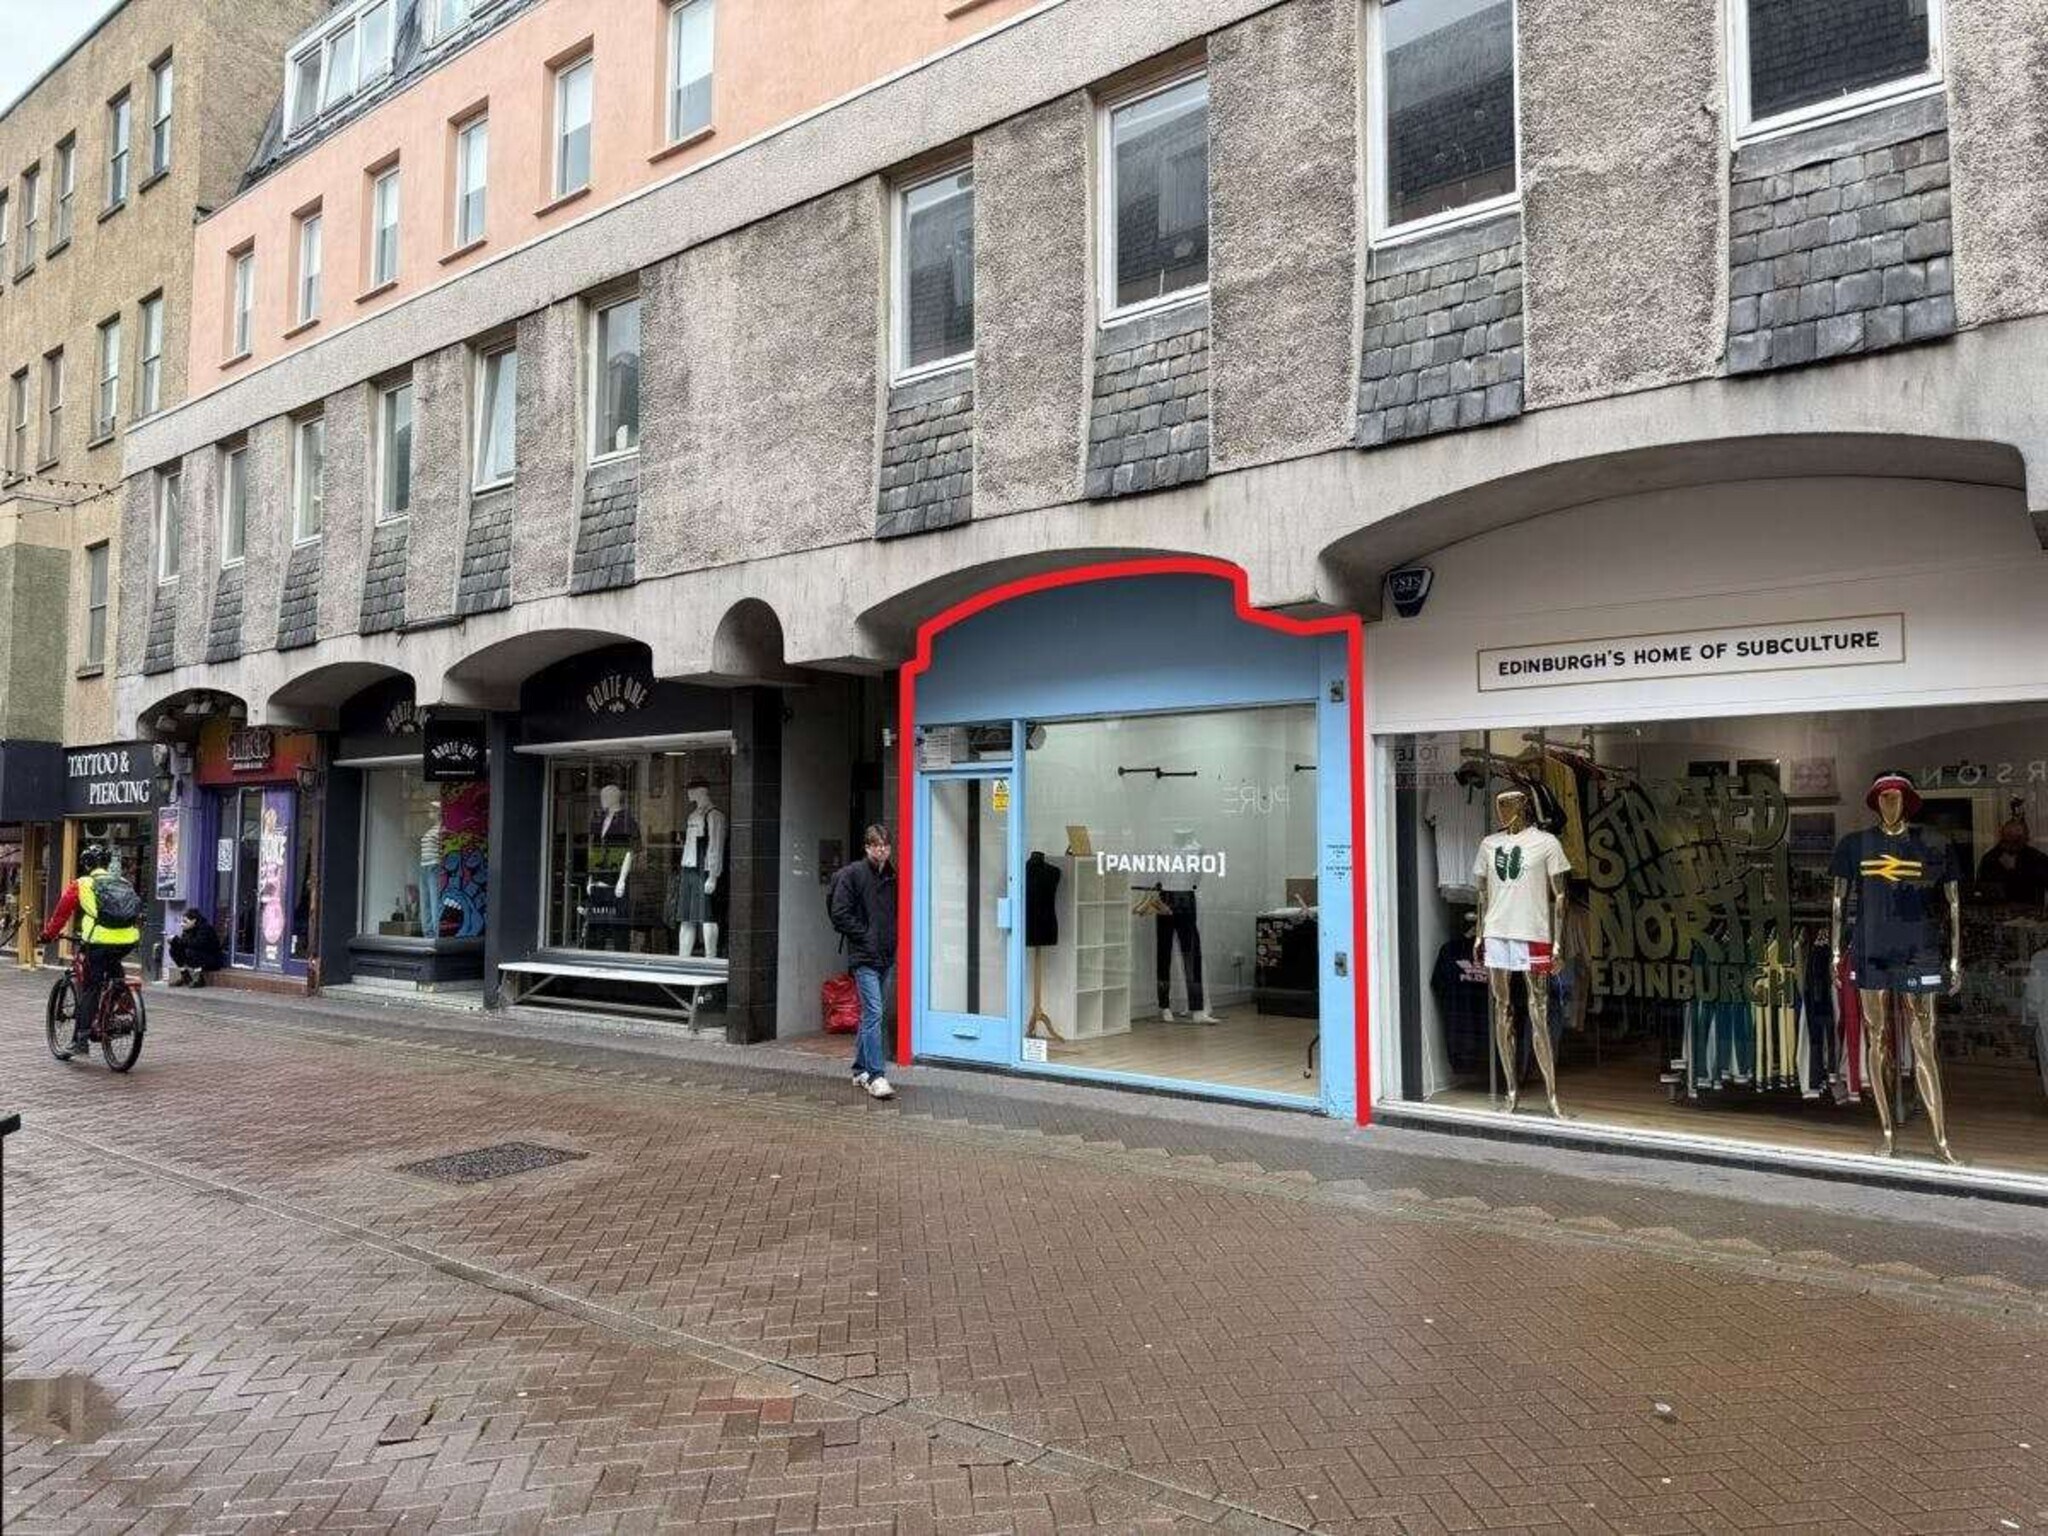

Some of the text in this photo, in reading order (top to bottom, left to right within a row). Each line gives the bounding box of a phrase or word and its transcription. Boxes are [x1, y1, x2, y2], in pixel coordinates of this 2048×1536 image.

[1498, 631, 1880, 676] EDINBURGH'S HOME OF SUBCULTURE
[586, 674, 622, 713] ROUTE
[68, 751, 130, 777] TATTOO &
[89, 778, 150, 804] PIERCING
[1096, 851, 1226, 877] [PANINARO]
[1587, 842, 1792, 964] NORTH
[1588, 958, 1796, 1008] EDINBURGH
